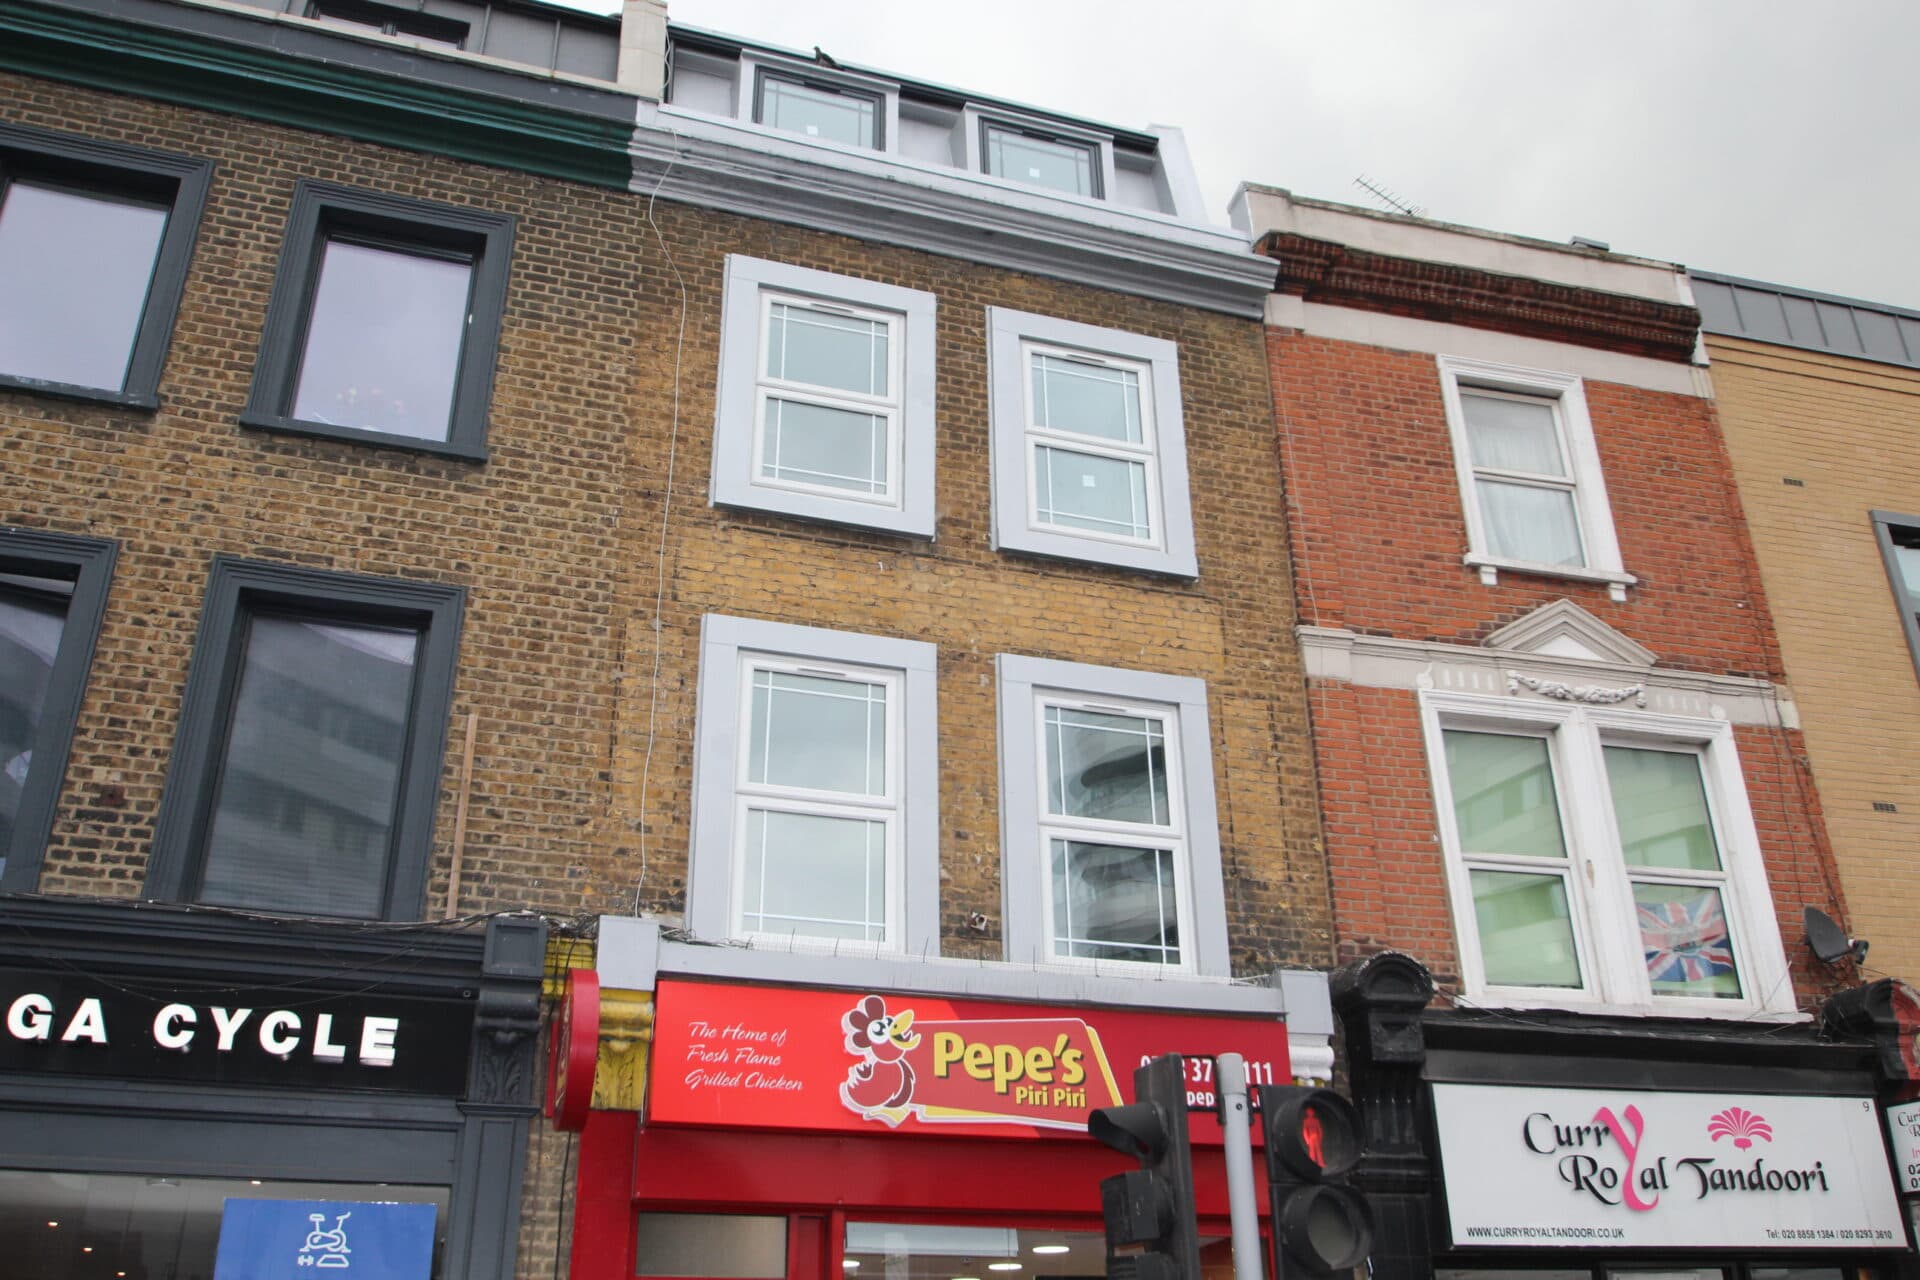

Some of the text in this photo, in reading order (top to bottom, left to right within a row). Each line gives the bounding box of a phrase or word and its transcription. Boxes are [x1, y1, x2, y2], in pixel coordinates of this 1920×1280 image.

[7, 993, 400, 1066] GA CYCLE
[688, 1021, 787, 1047] The Home of
[687, 1044, 781, 1066] Fresh Flame
[934, 1031, 1085, 1094] Pepe's
[684, 1069, 803, 1092] Grilled Chicken
[1190, 1057, 1214, 1082] 37
[1242, 1060, 1273, 1086] 111
[1015, 1084, 1086, 1109] Piri Piri
[1558, 1152, 1829, 1212] Royal Tandoori
[1466, 1226, 1625, 1239] WWW.CURRYROYALTANDOORI.CO.UK
[1766, 1229, 1780, 1239] Tel:
[1781, 1229, 1796, 1239] 020
[1840, 1229, 1854, 1239] 020
